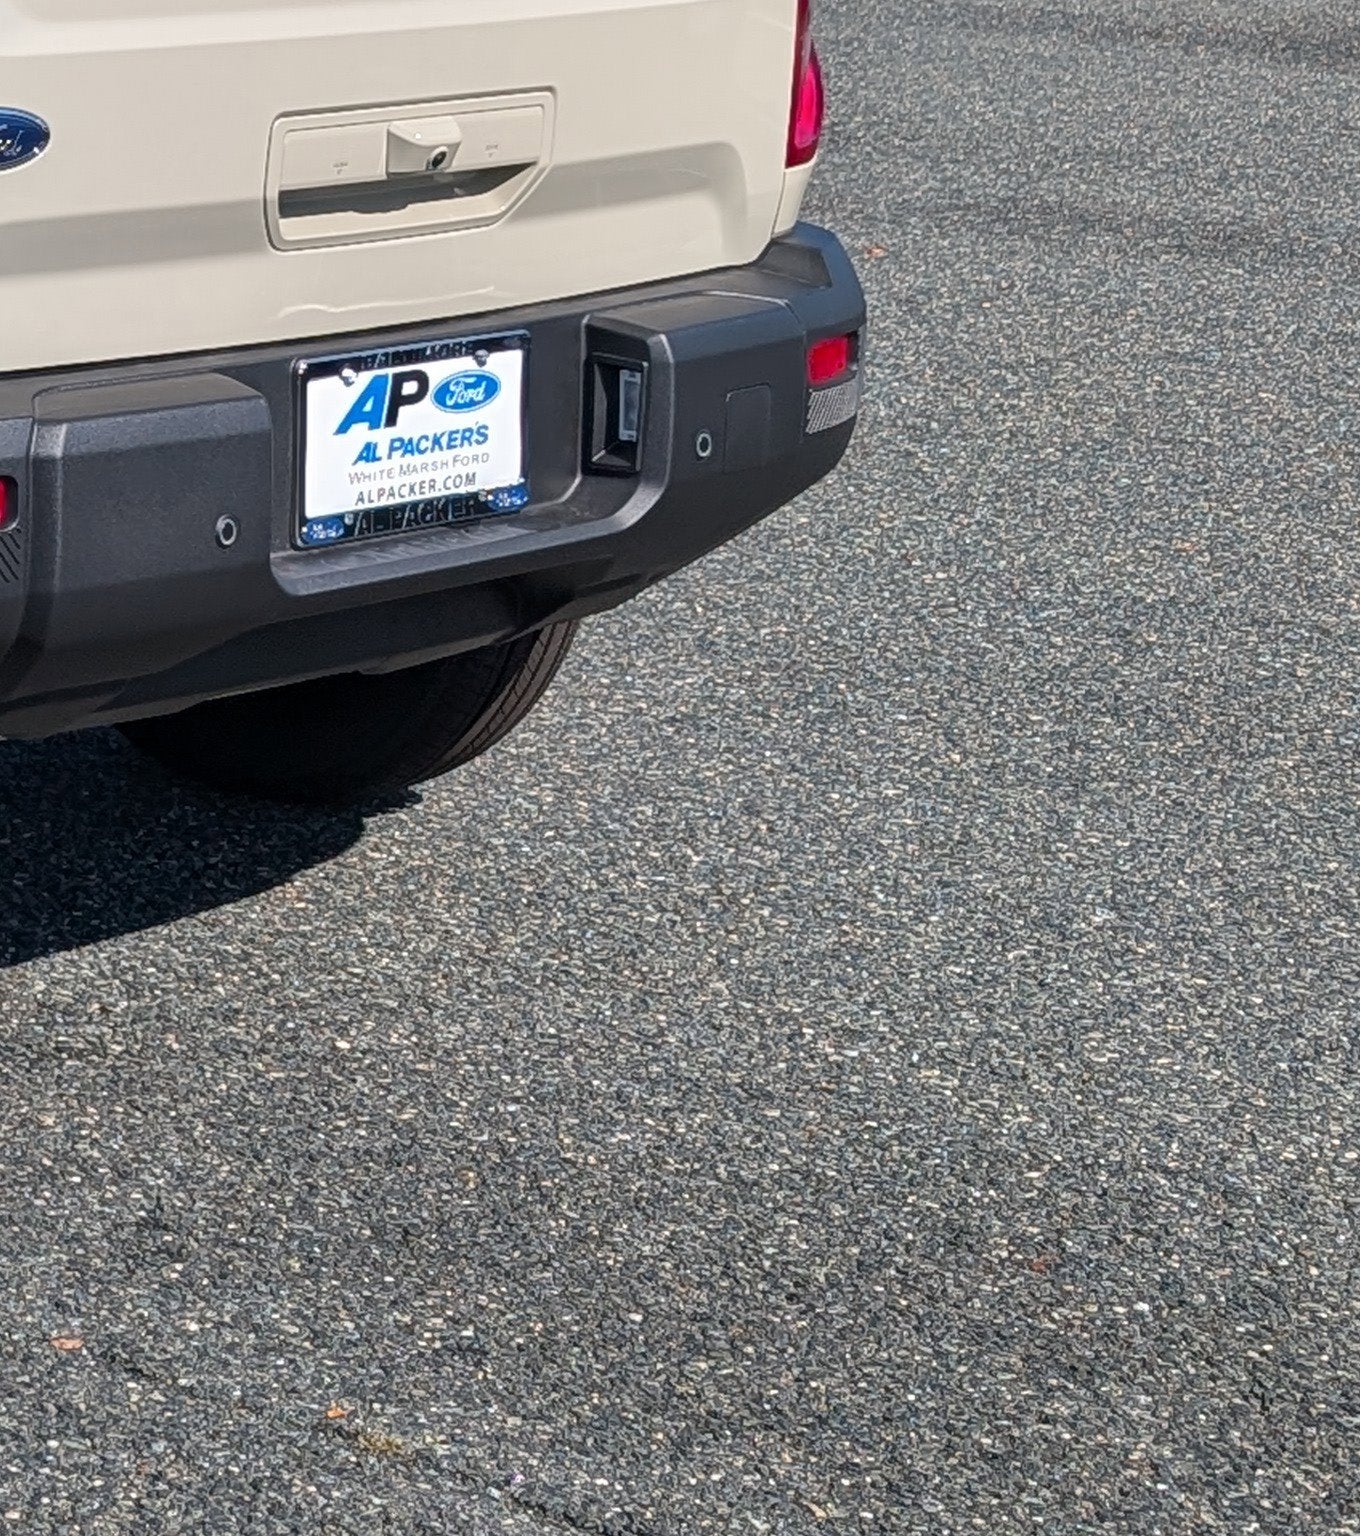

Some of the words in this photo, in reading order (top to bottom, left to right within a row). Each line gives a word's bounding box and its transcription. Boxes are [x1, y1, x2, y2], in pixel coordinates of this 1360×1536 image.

[333, 369, 429, 435] AP
[446, 376, 487, 406] Ford
[348, 468, 396, 485] WHITE
[398, 458, 448, 477] MARSH
[452, 452, 490, 469] FORD
[352, 441, 382, 466] AL
[355, 472, 477, 506] ALPACKER.COM
